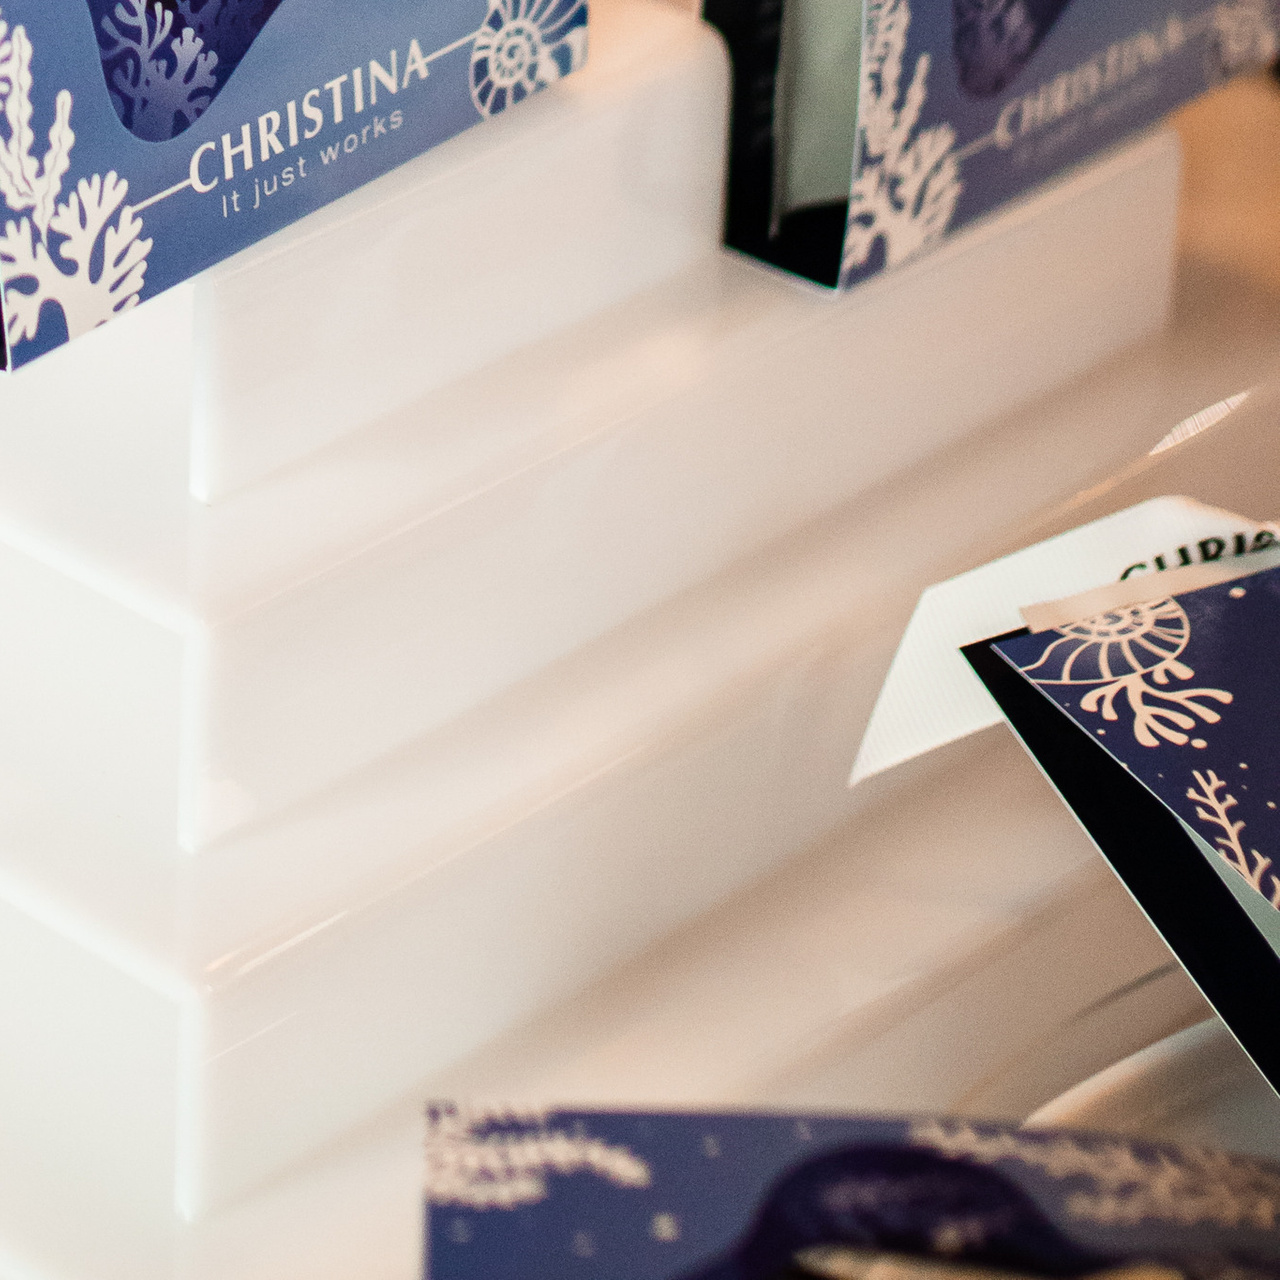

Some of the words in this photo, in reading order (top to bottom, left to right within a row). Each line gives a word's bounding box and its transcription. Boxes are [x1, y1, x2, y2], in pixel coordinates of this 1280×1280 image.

[190, 38, 430, 194] CHRISTINA
[222, 190, 240, 218] It
[253, 157, 307, 209] just
[320, 110, 404, 166] works
